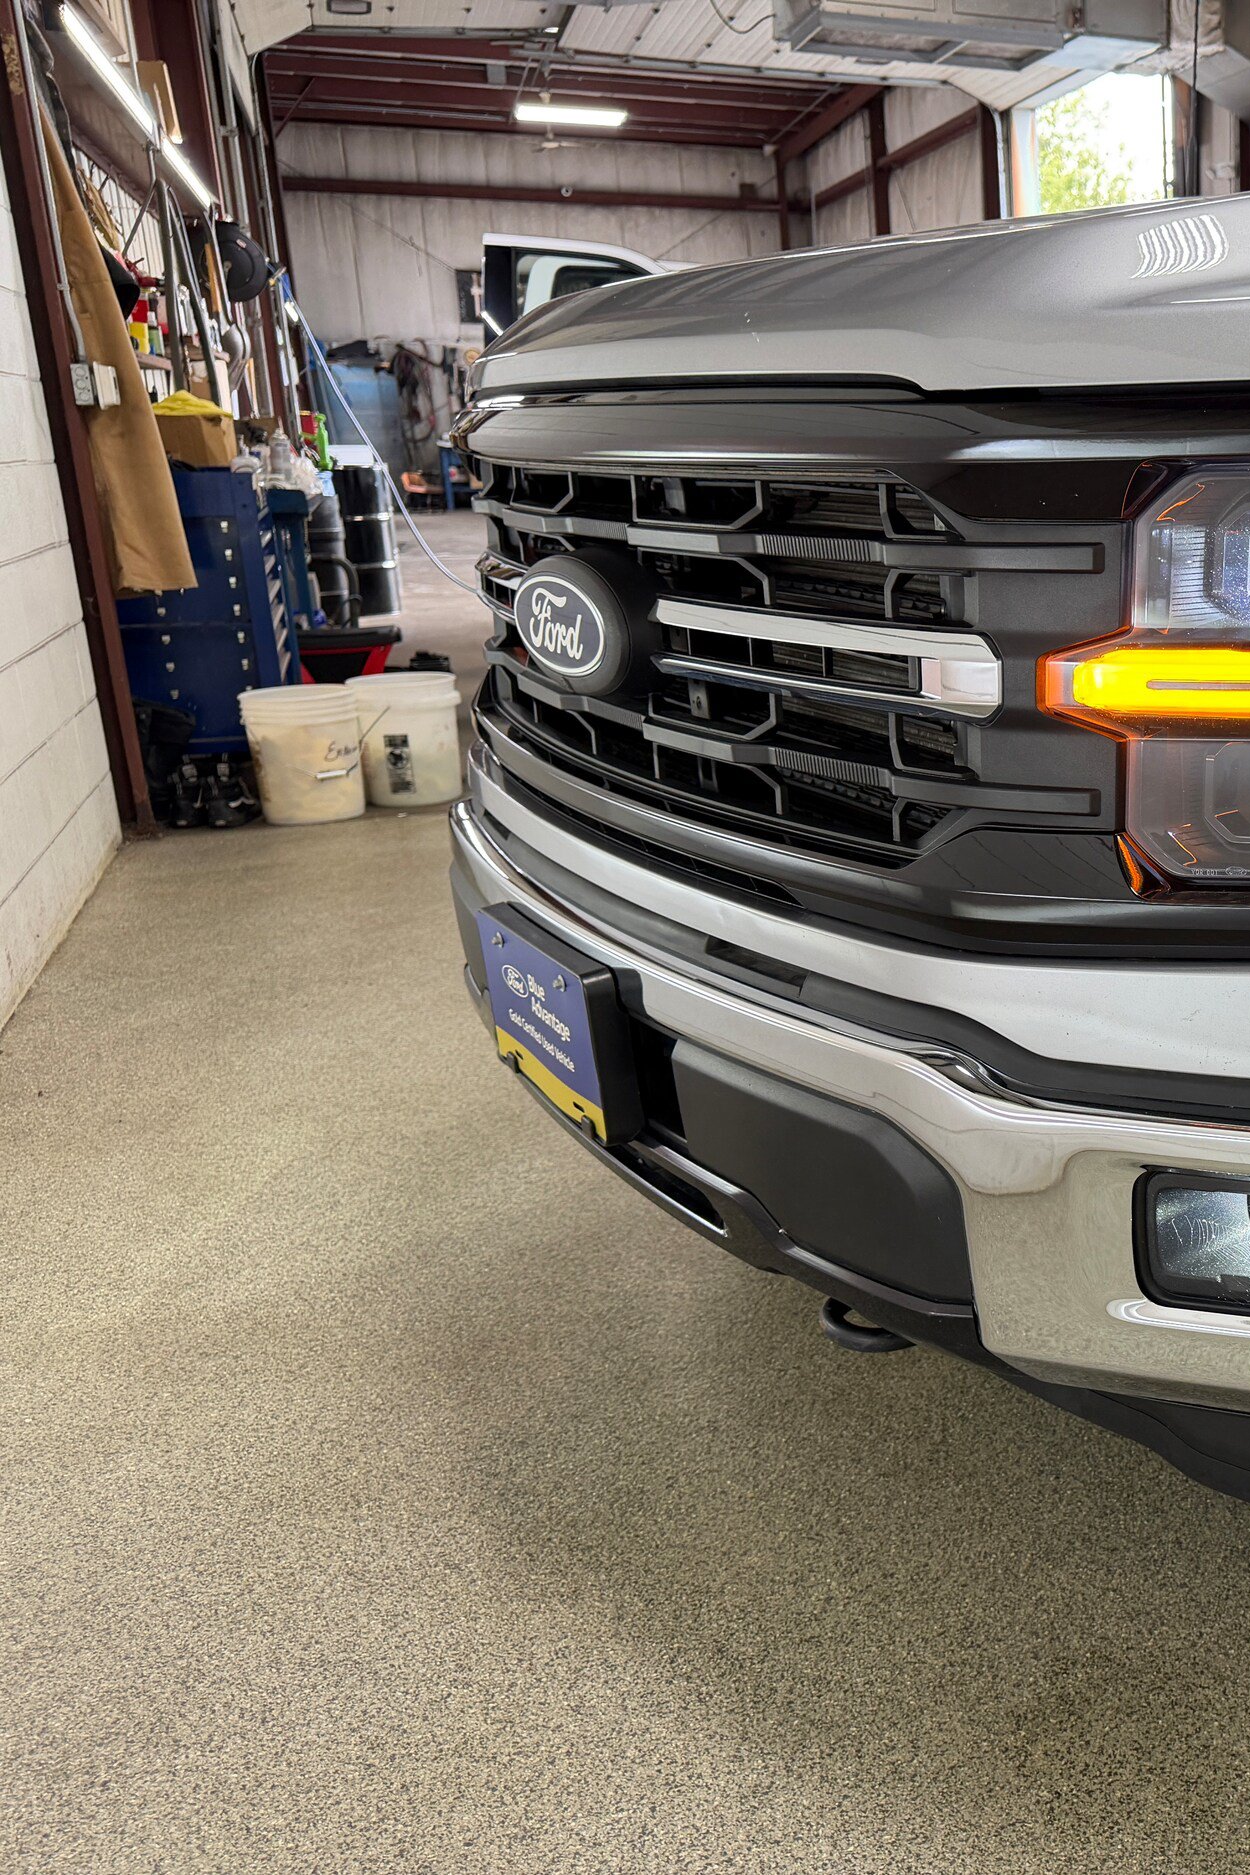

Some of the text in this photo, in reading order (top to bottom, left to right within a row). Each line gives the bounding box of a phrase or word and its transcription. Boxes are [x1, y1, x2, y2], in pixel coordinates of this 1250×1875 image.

[529, 587, 583, 660] Ford
[506, 968, 525, 994] Ford
[527, 974, 546, 1002] Blue
[531, 996, 571, 1042] Advantage
